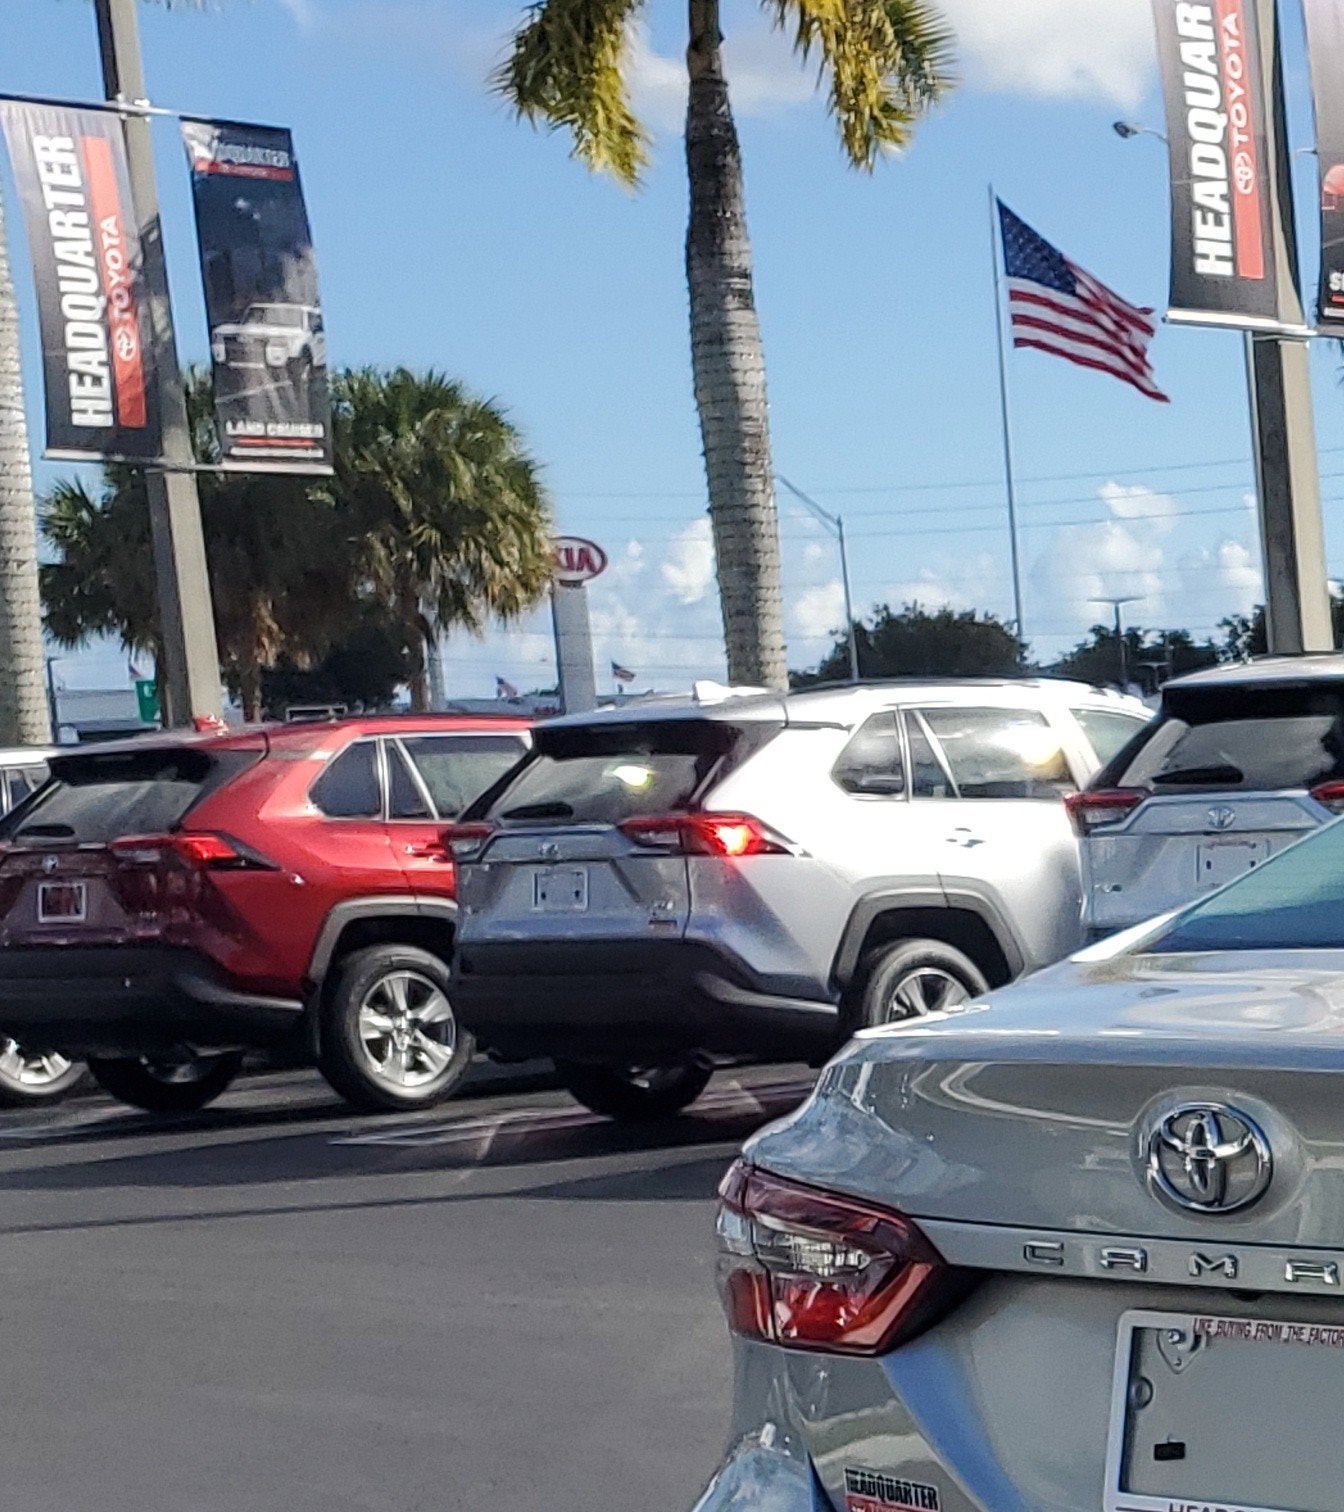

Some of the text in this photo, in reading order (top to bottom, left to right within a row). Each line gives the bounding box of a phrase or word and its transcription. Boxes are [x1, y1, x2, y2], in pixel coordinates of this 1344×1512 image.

[1176, 0, 1234, 277] HEADQUAR
[1222, 12, 1249, 149] TOYOTA
[33, 134, 114, 427] HEADQUARTER
[99, 214, 134, 321] TOYOTA
[1254, 1322, 1283, 1342] FROM
[1285, 1325, 1306, 1343] THE
[845, 1467, 939, 1511] HEADQUARTER
